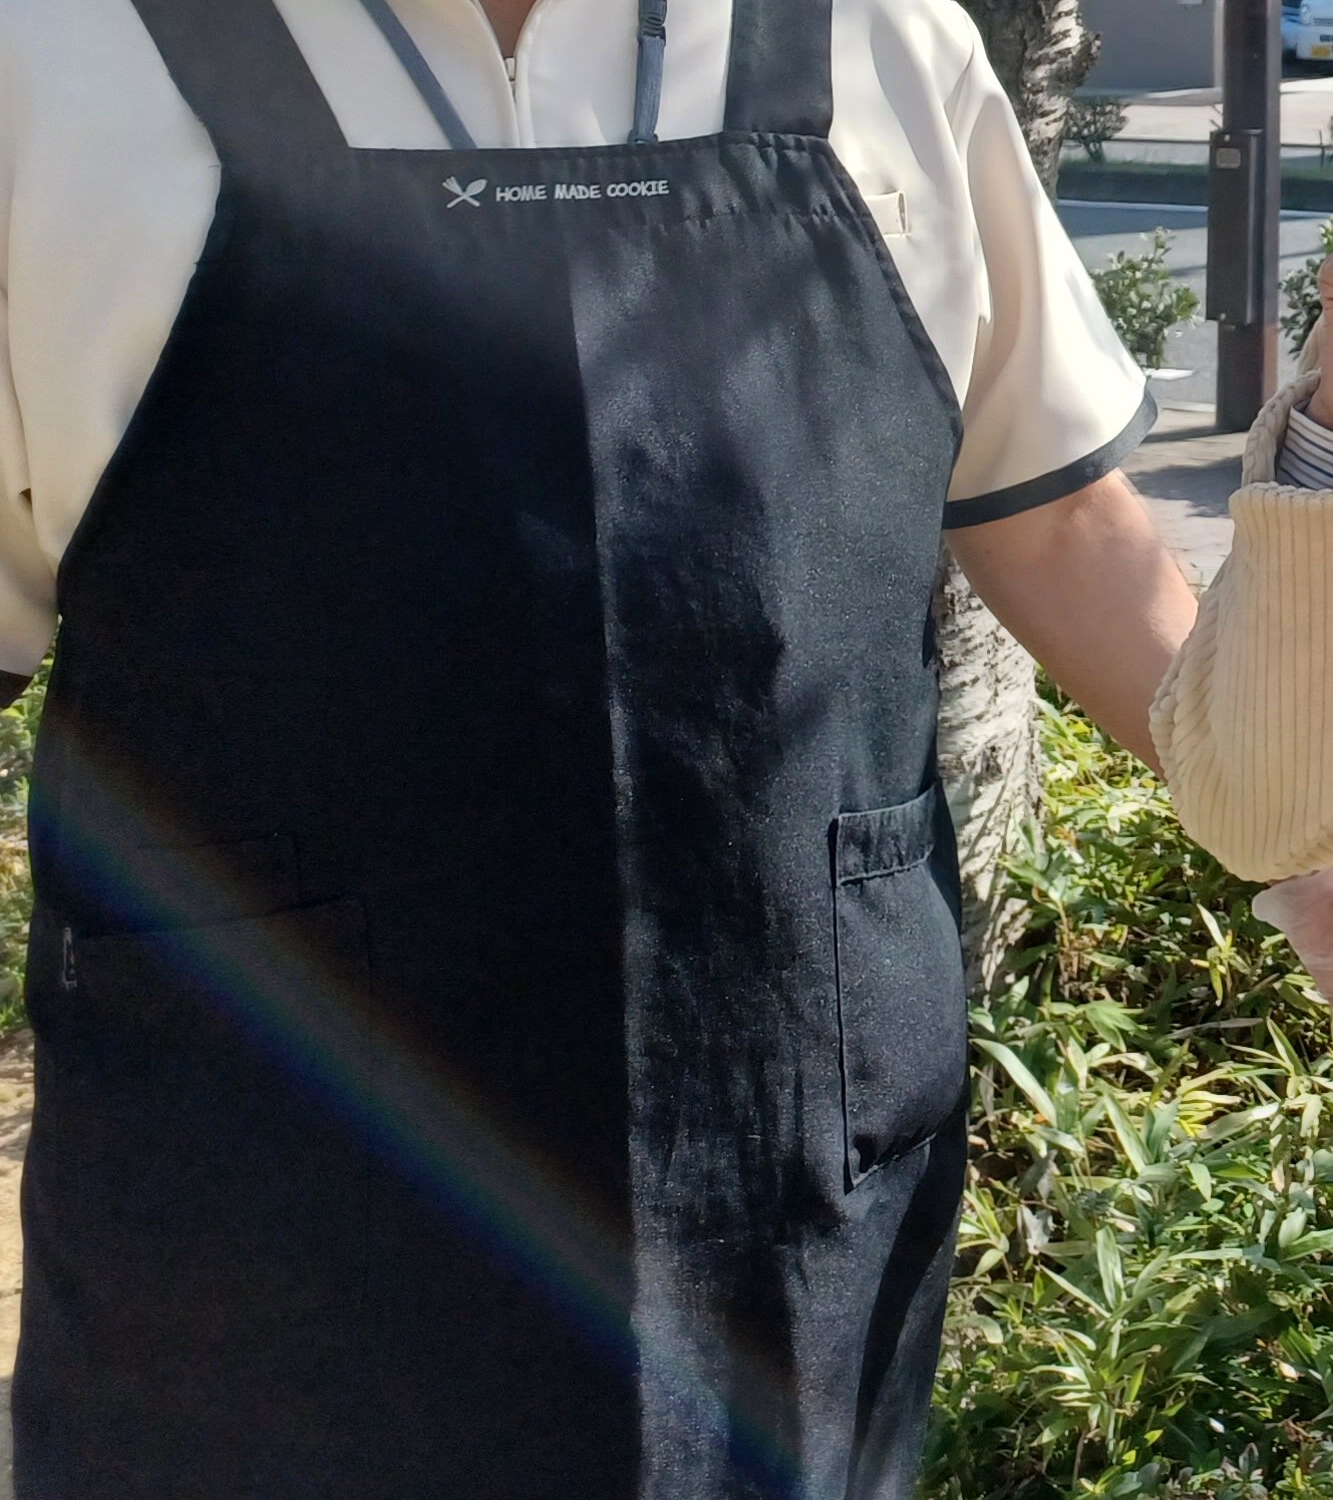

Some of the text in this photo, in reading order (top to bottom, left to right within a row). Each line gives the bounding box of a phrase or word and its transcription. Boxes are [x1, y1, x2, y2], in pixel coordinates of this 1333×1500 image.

[496, 180, 670, 202] HOME MADE COOKIE
